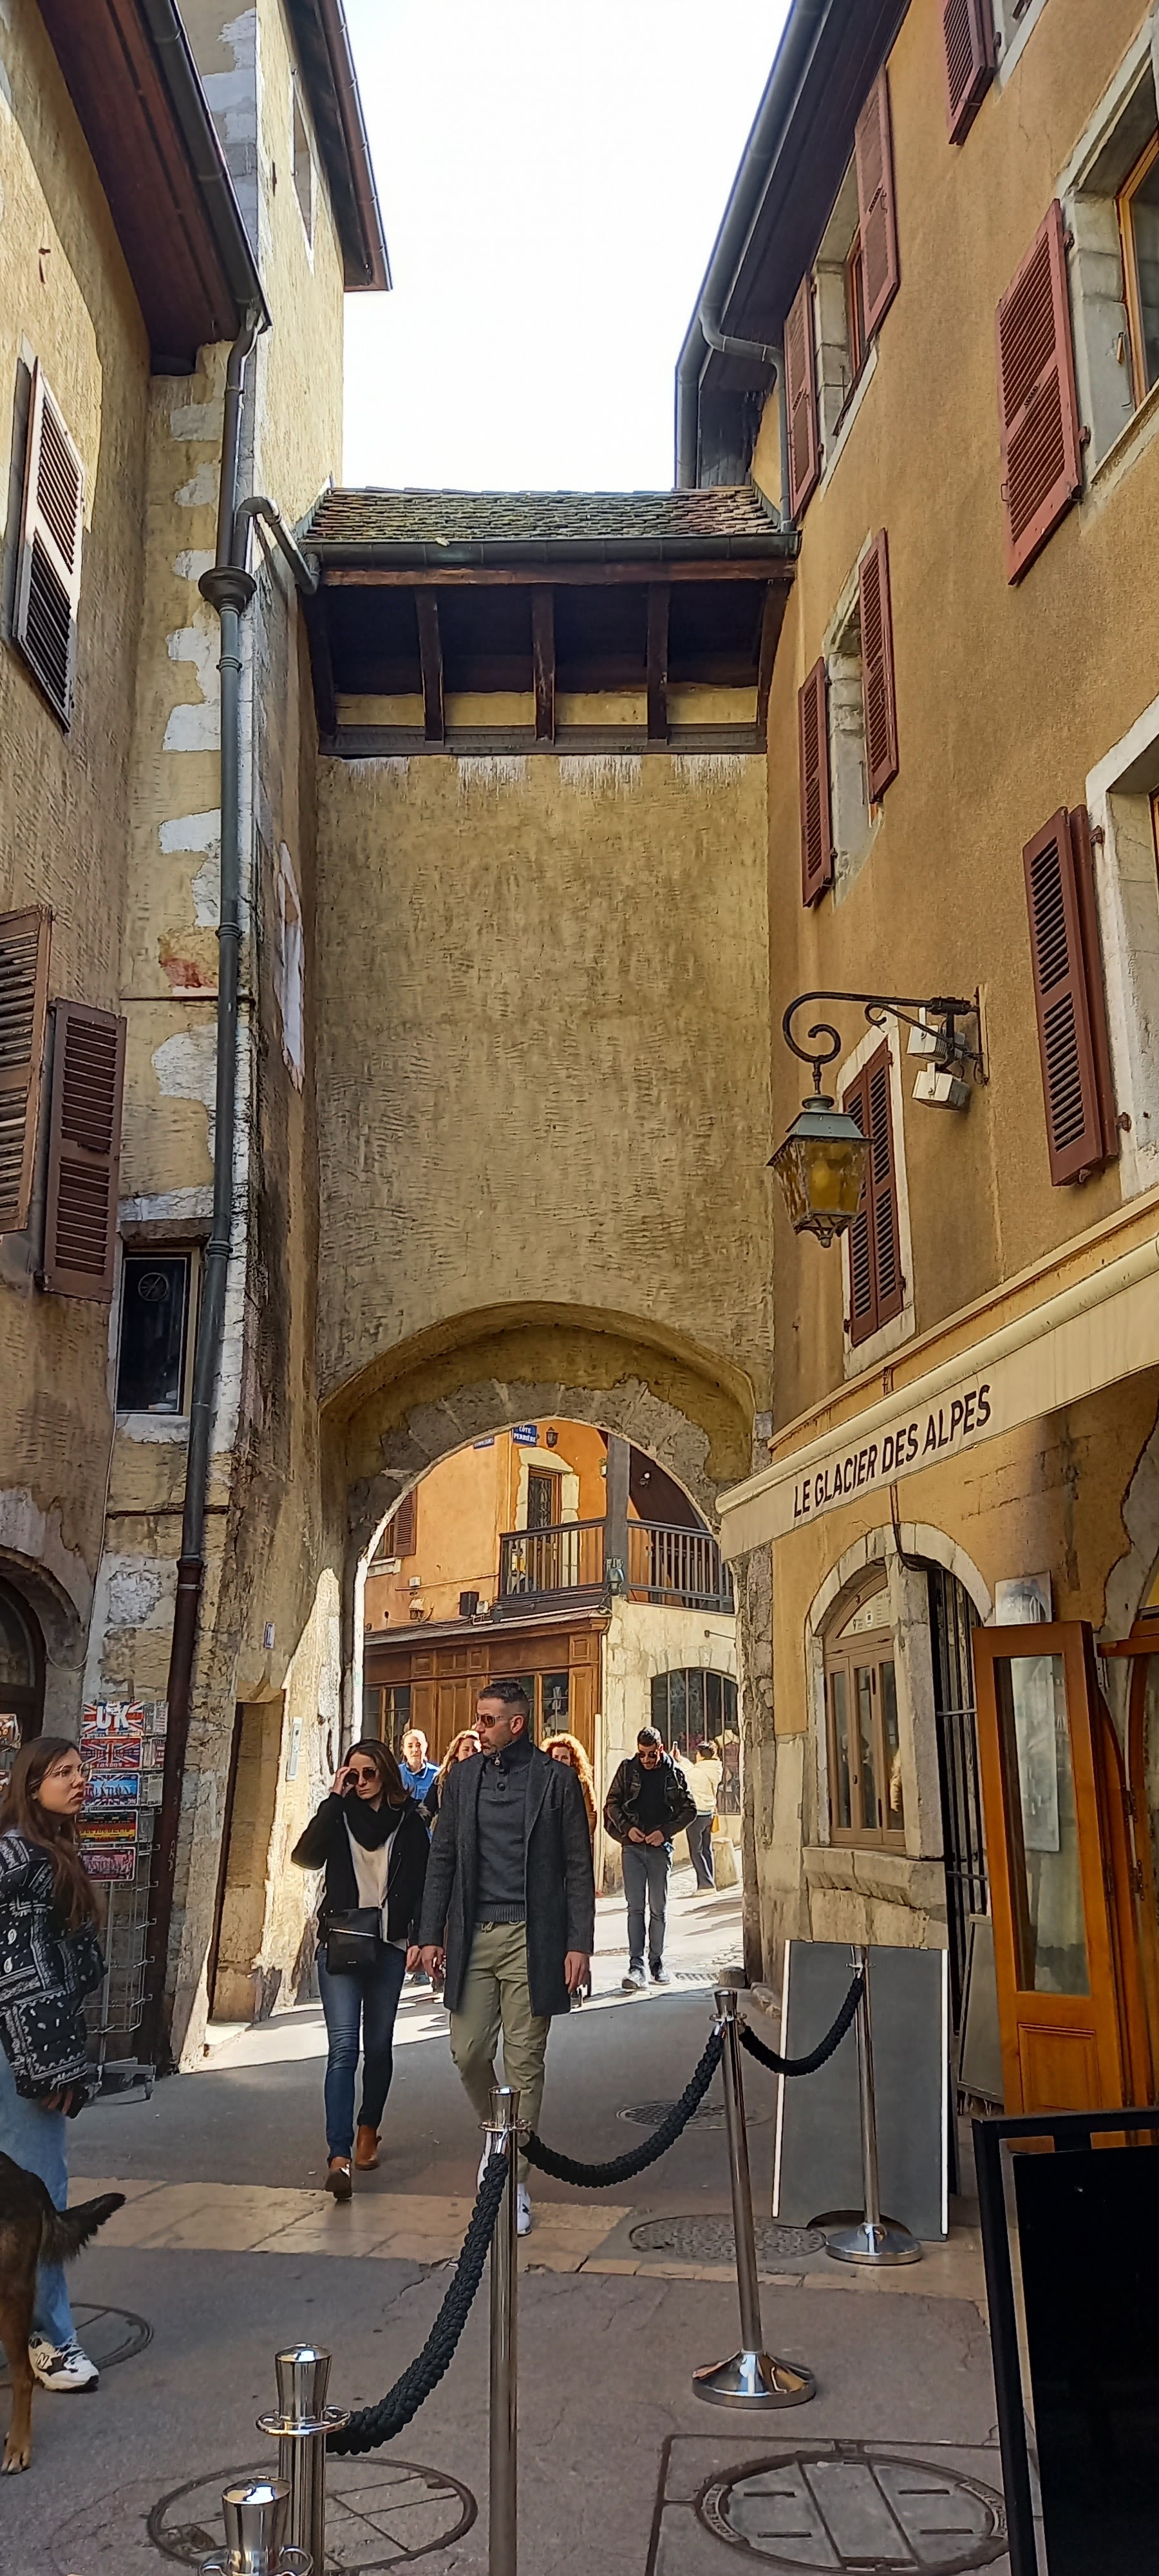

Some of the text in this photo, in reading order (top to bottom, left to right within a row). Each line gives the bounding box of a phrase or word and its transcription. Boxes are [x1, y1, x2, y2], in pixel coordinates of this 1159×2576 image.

[793, 1384, 991, 1519] LE GLACIER DES ALPES
[96, 1704, 131, 1730] UK
